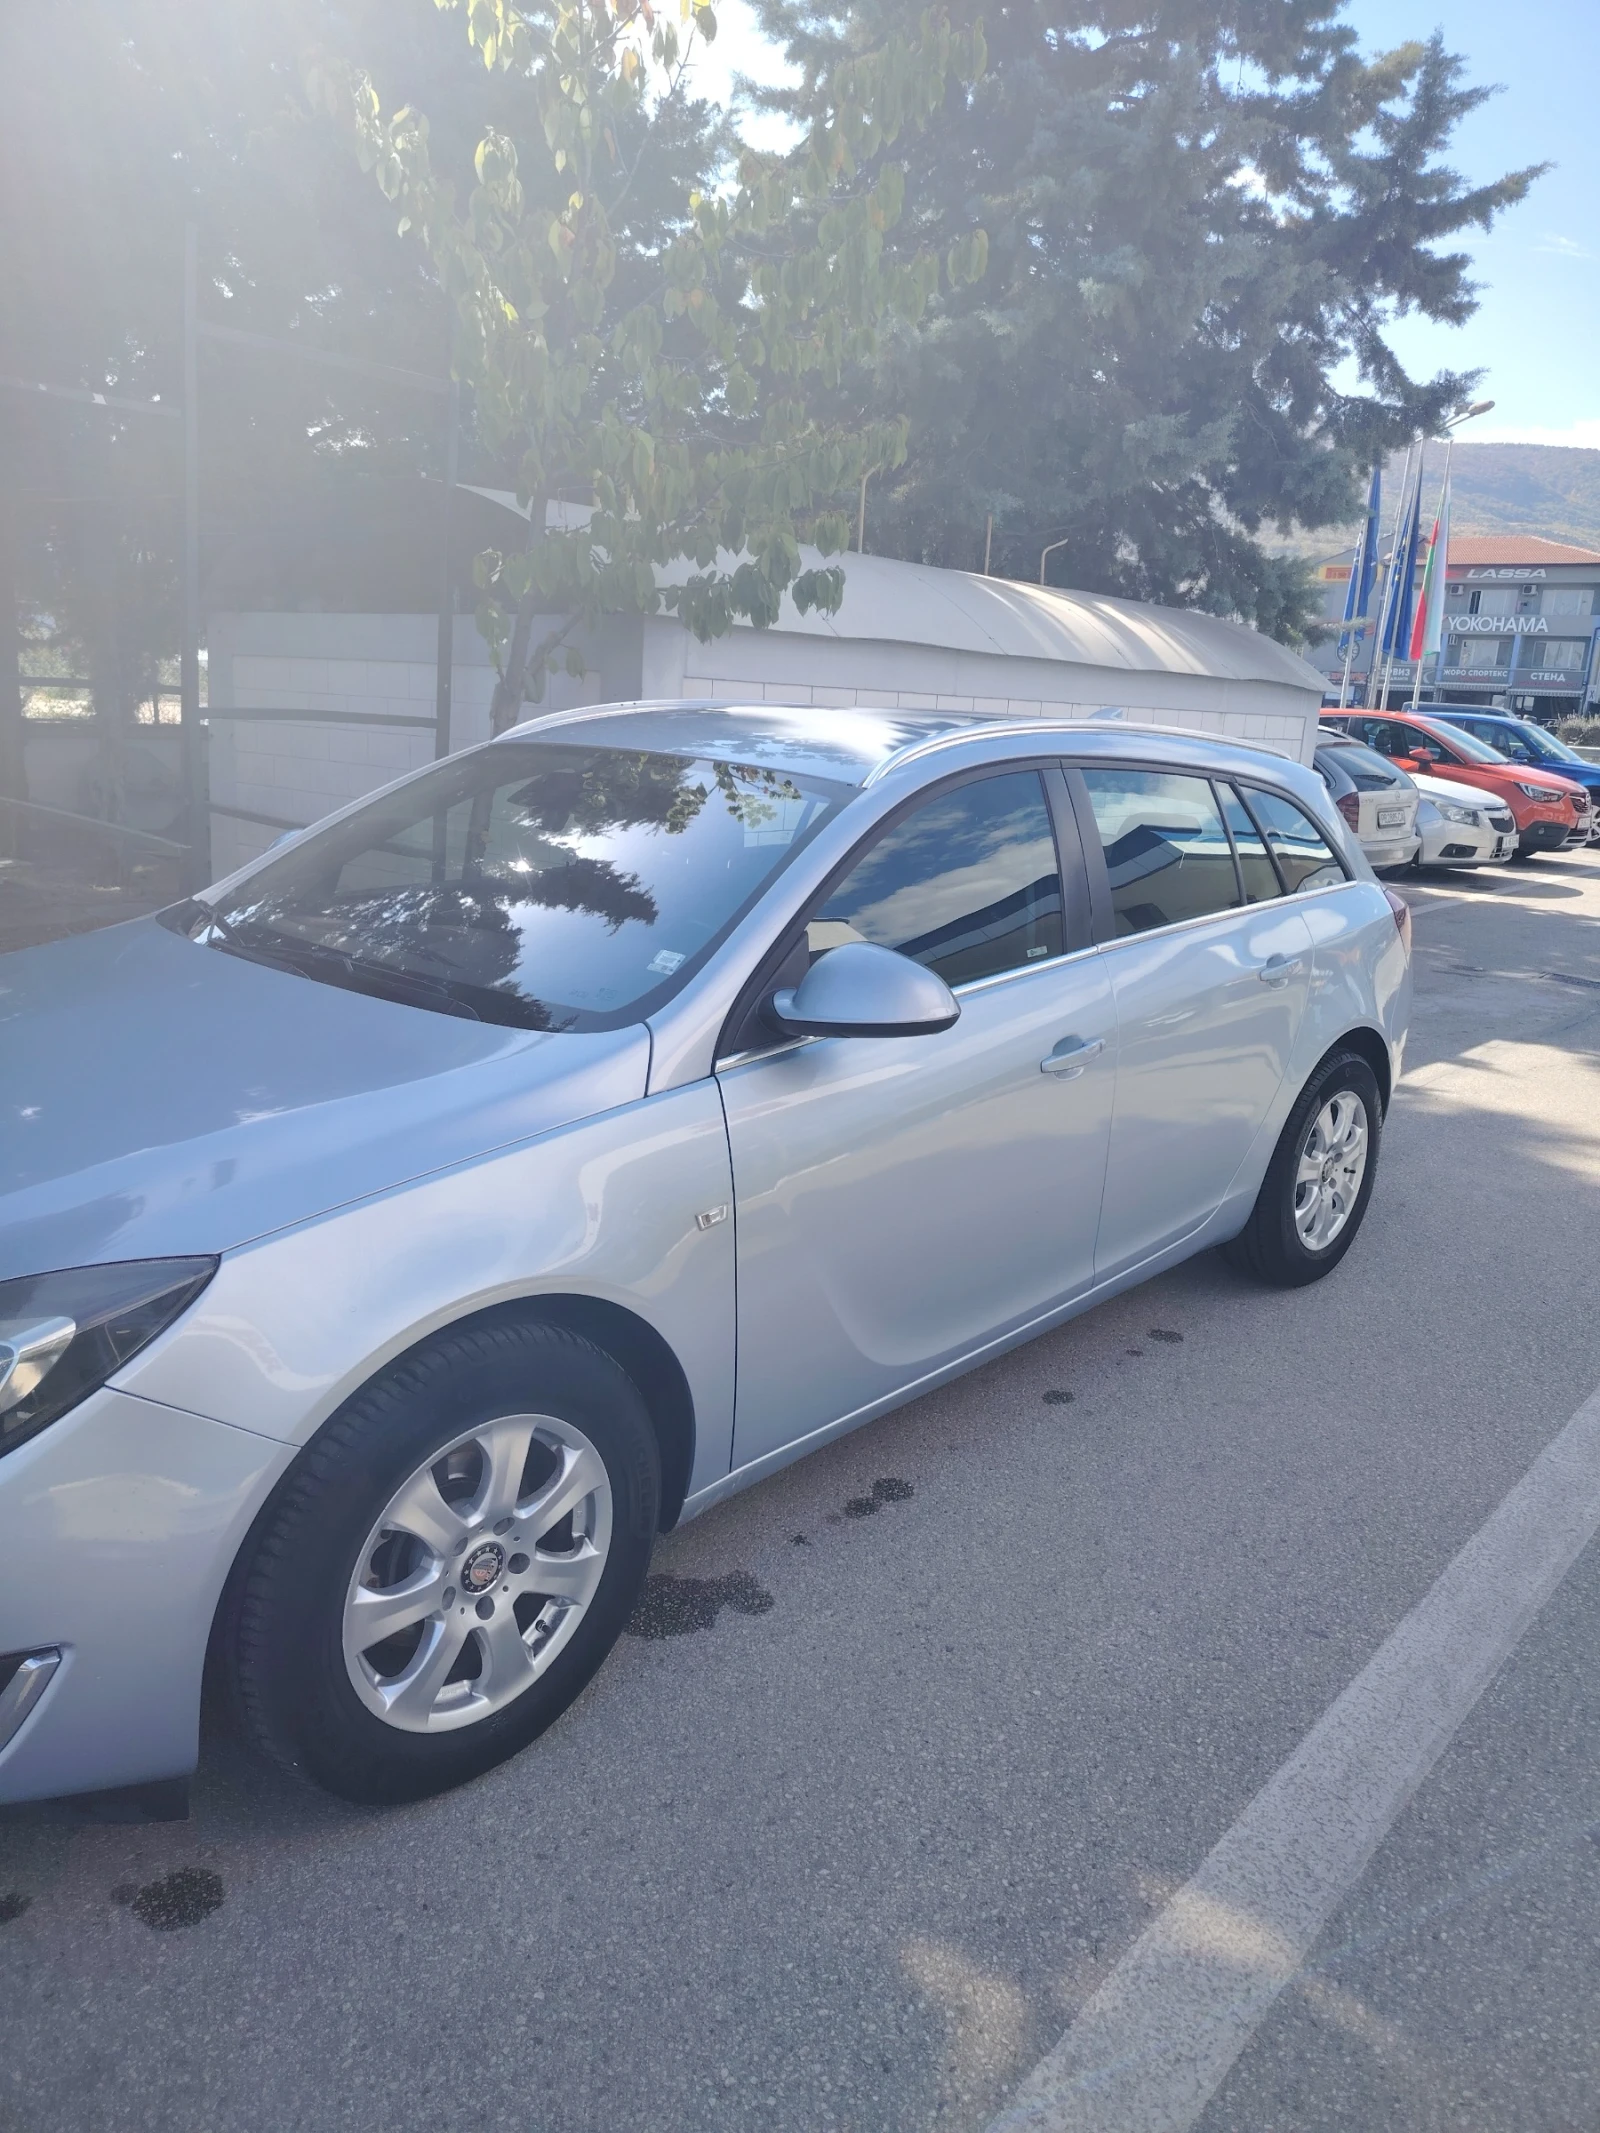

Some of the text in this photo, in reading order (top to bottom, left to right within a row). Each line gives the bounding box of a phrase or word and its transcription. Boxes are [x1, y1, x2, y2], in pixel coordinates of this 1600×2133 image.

[1467, 568, 1547, 579] LASSA
[1448, 616, 1549, 633] YOKOHAMA
[1378, 667, 1411, 677] ЕВИЗ
[1443, 668, 1508, 678] ЖОРО СПОРТЕКС
[1530, 672, 1566, 682] СТЕНД
